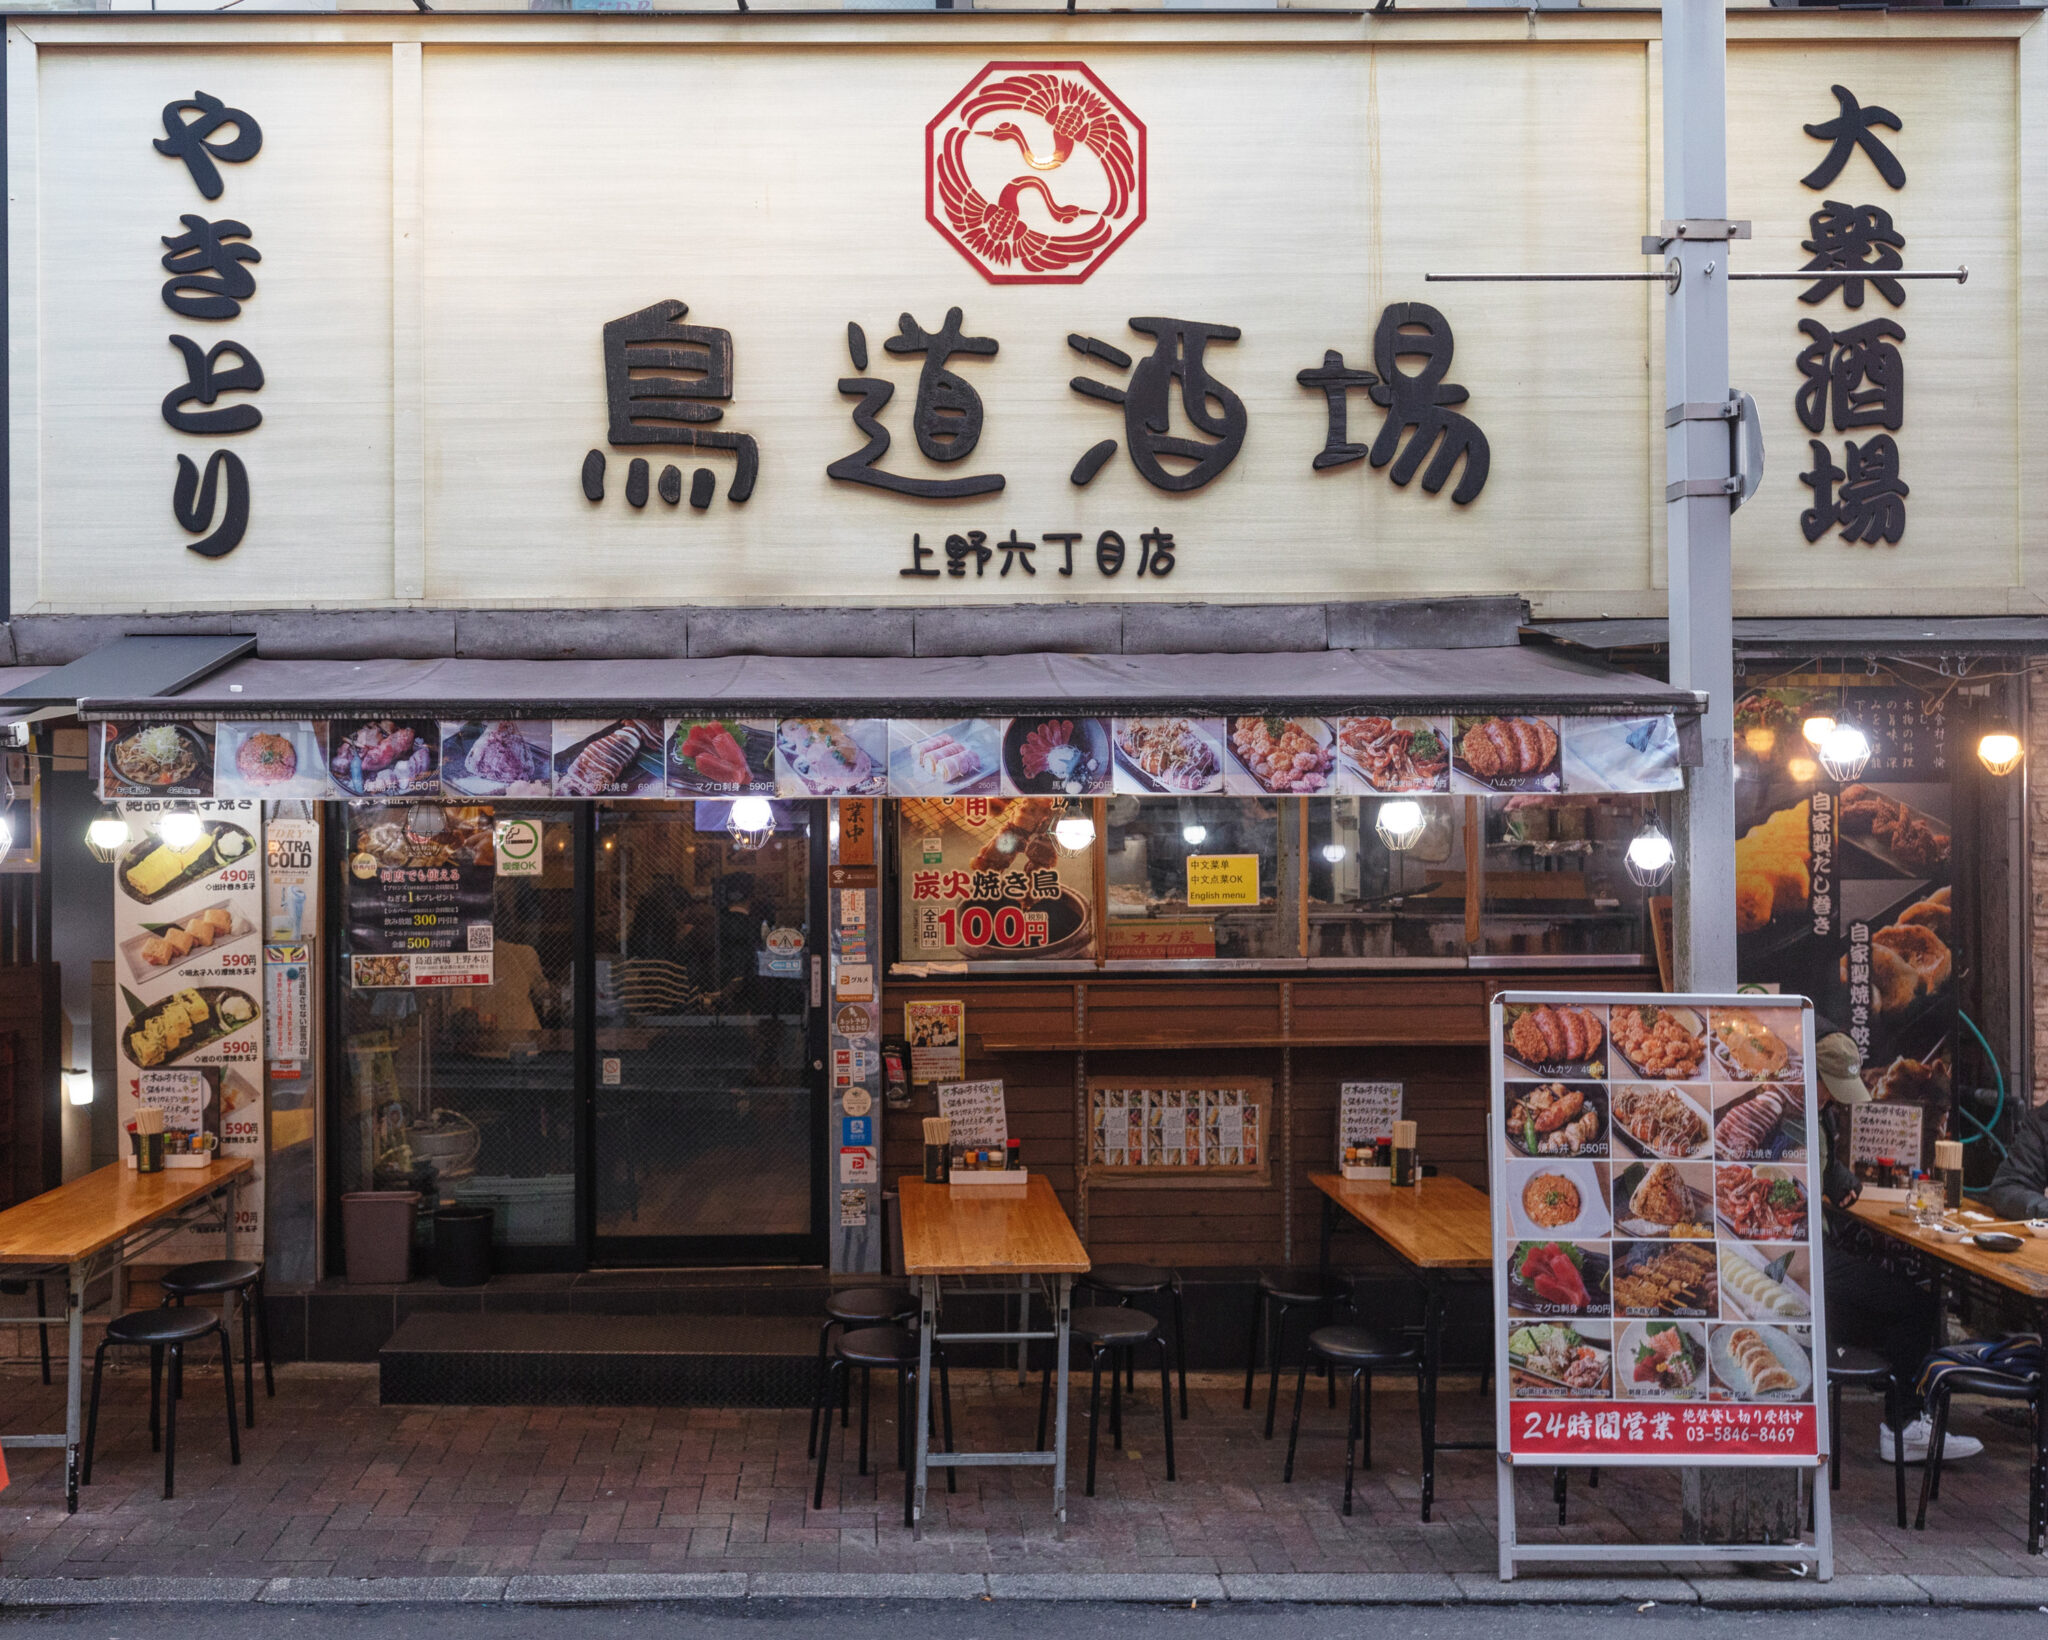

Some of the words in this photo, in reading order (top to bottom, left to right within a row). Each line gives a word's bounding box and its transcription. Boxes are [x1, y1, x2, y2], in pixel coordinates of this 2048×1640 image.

[1795, 84, 1909, 545] 大衆酒場
[153, 90, 264, 557] やきとり
[582, 299, 1491, 508] 鳥道酒場
[900, 528, 1176, 578] 上野六丁目店
[409, 780, 440, 792] 550円
[695, 782, 741, 792] マグロ刺身
[749, 782, 775, 792] 590円
[1490, 776, 1526, 788] ハムカツ
[845, 800, 867, 843] 業中
[268, 840, 312, 853] EXTRA
[267, 852, 312, 868] COLD
[502, 861, 537, 871] 喫煙OK
[1191, 860, 1229, 870] 中文菜单
[1811, 792, 1831, 936] 自家製だし巻き
[220, 869, 256, 882] 490円
[1191, 874, 1243, 884] 中文点菜OK
[913, 870, 1060, 900] 炭火焼き鳥
[1190, 890, 1220, 901] English
[1222, 891, 1246, 899] menu
[923, 909, 938, 939] 全品
[938, 907, 1049, 947] 100円
[222, 954, 257, 966] 590円
[223, 1041, 258, 1054] 590円
[1538, 1064, 1573, 1074] ハムカツ
[225, 1122, 259, 1135] 590円
[1580, 1143, 1609, 1154] 550円
[1534, 1303, 1579, 1314] マグロ刺身
[1586, 1303, 1612, 1314] 590円
[1522, 1410, 1676, 1441] 24時間営業
[1682, 1409, 1804, 1425] 絶賛貸し切り受付中
[1687, 1426, 1795, 1443] 03-5846-8469
